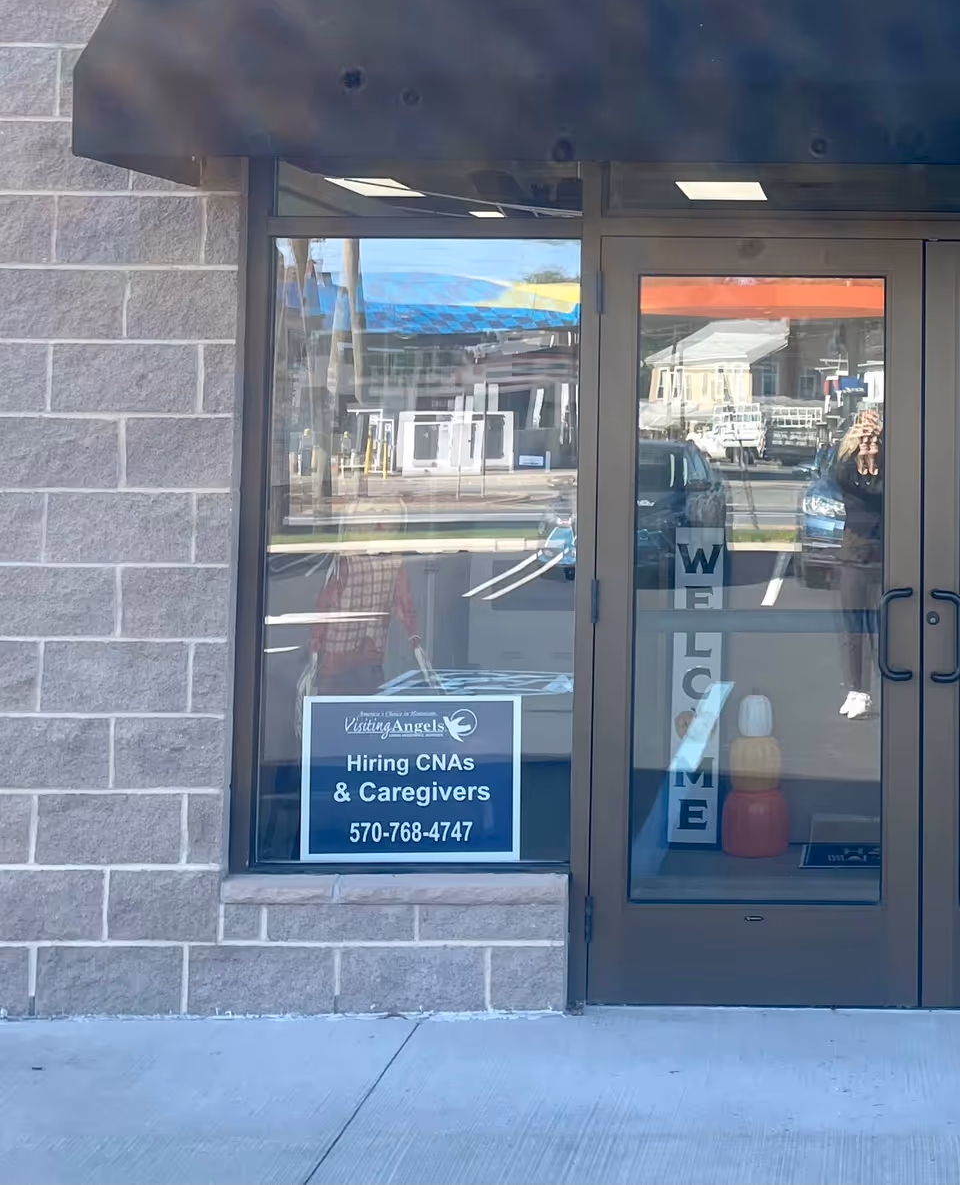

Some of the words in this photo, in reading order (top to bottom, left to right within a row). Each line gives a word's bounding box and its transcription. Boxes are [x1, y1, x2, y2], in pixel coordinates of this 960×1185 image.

[344, 717, 392, 739] Visiting
[392, 718, 445, 735] Angels
[347, 754, 409, 776] Hiring
[416, 753, 475, 771] CNAs
[333, 781, 351, 803] &
[359, 781, 491, 807] Caregivers
[349, 821, 473, 843] 570-768-4747
